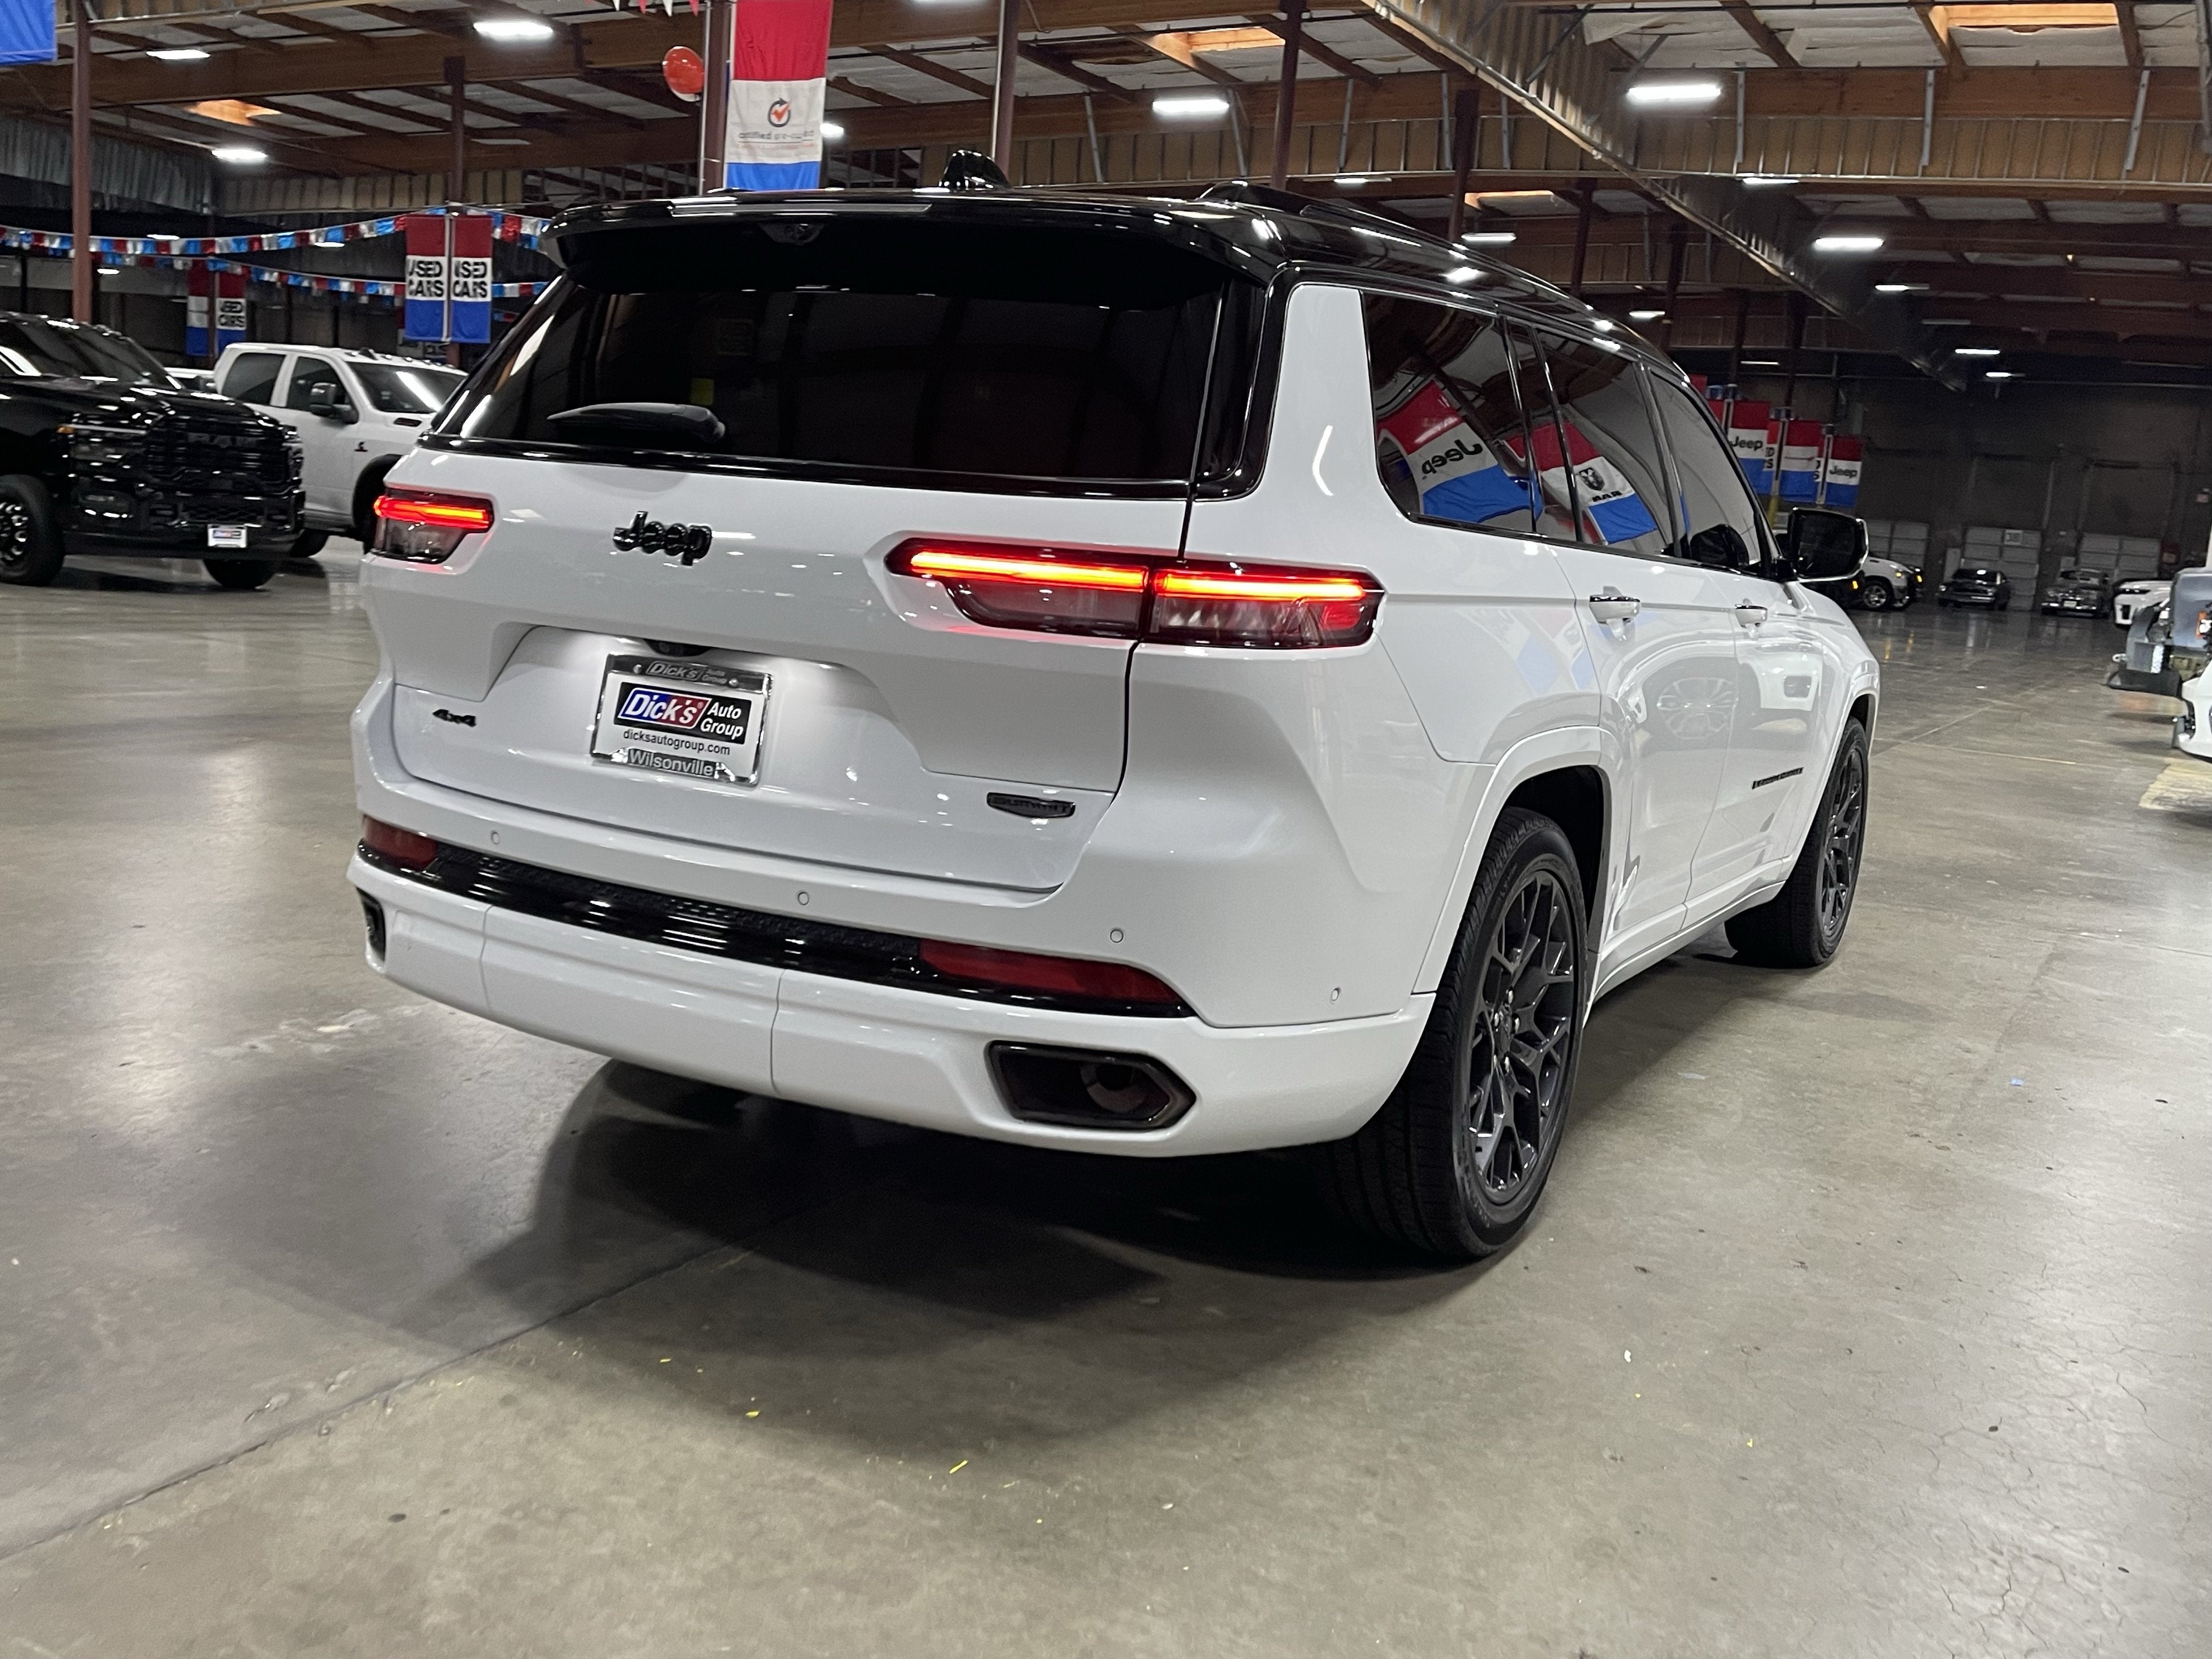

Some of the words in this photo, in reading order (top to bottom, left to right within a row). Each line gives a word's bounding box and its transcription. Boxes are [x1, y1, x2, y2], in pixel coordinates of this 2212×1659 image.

[1729, 436, 1763, 451] Jeep
[1829, 465, 1858, 479] Jeep
[613, 511, 712, 566] Jeep
[650, 663, 698, 679] Dick's
[624, 693, 698, 724] Dick's
[707, 702, 742, 719] Auto
[700, 718, 744, 740] Group
[623, 729, 730, 755] dicksautogroup.com
[630, 750, 713, 776] Wilsonville
